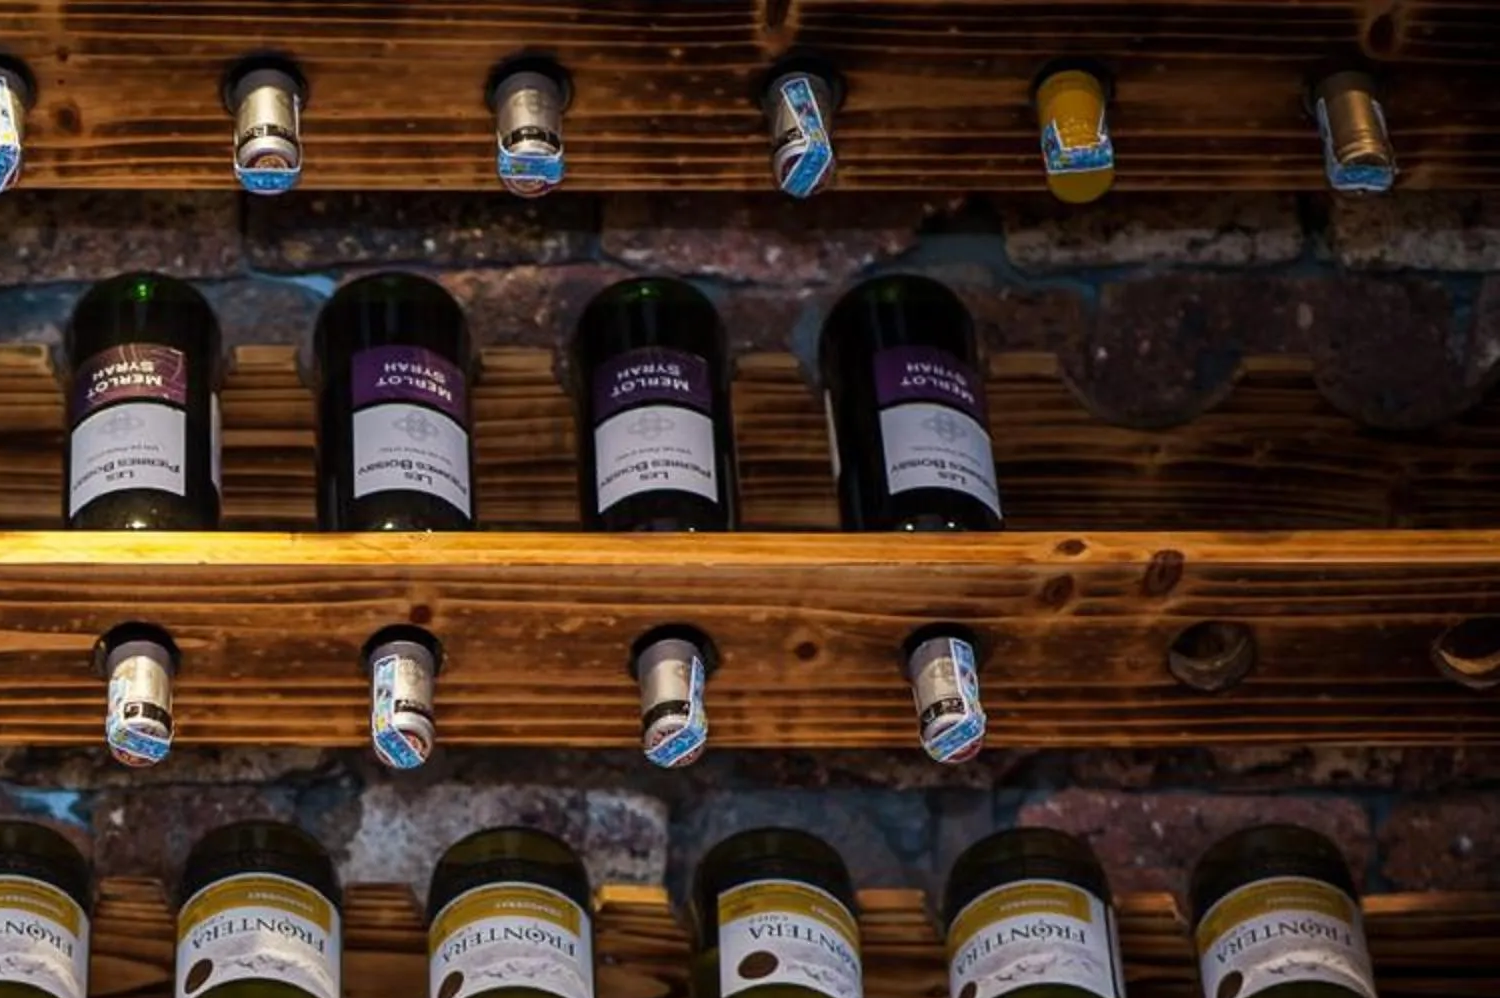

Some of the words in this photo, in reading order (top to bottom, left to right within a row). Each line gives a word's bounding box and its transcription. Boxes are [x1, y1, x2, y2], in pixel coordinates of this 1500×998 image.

[92, 360, 155, 380] SYRAH
[383, 362, 446, 382] SYRAH
[617, 361, 681, 381] SYRAH
[906, 362, 968, 385] SYRAH
[86, 374, 162, 398] MERLOT
[376, 375, 453, 401] MERLOT
[610, 374, 690, 397] MERLOT
[900, 374, 974, 402] MERLOT
[191, 918, 325, 954] FRONTERA
[442, 927, 575, 963] FRONTERA
[1216, 922, 1354, 963] FRONTERA
[956, 923, 1086, 975] FRONTERA
